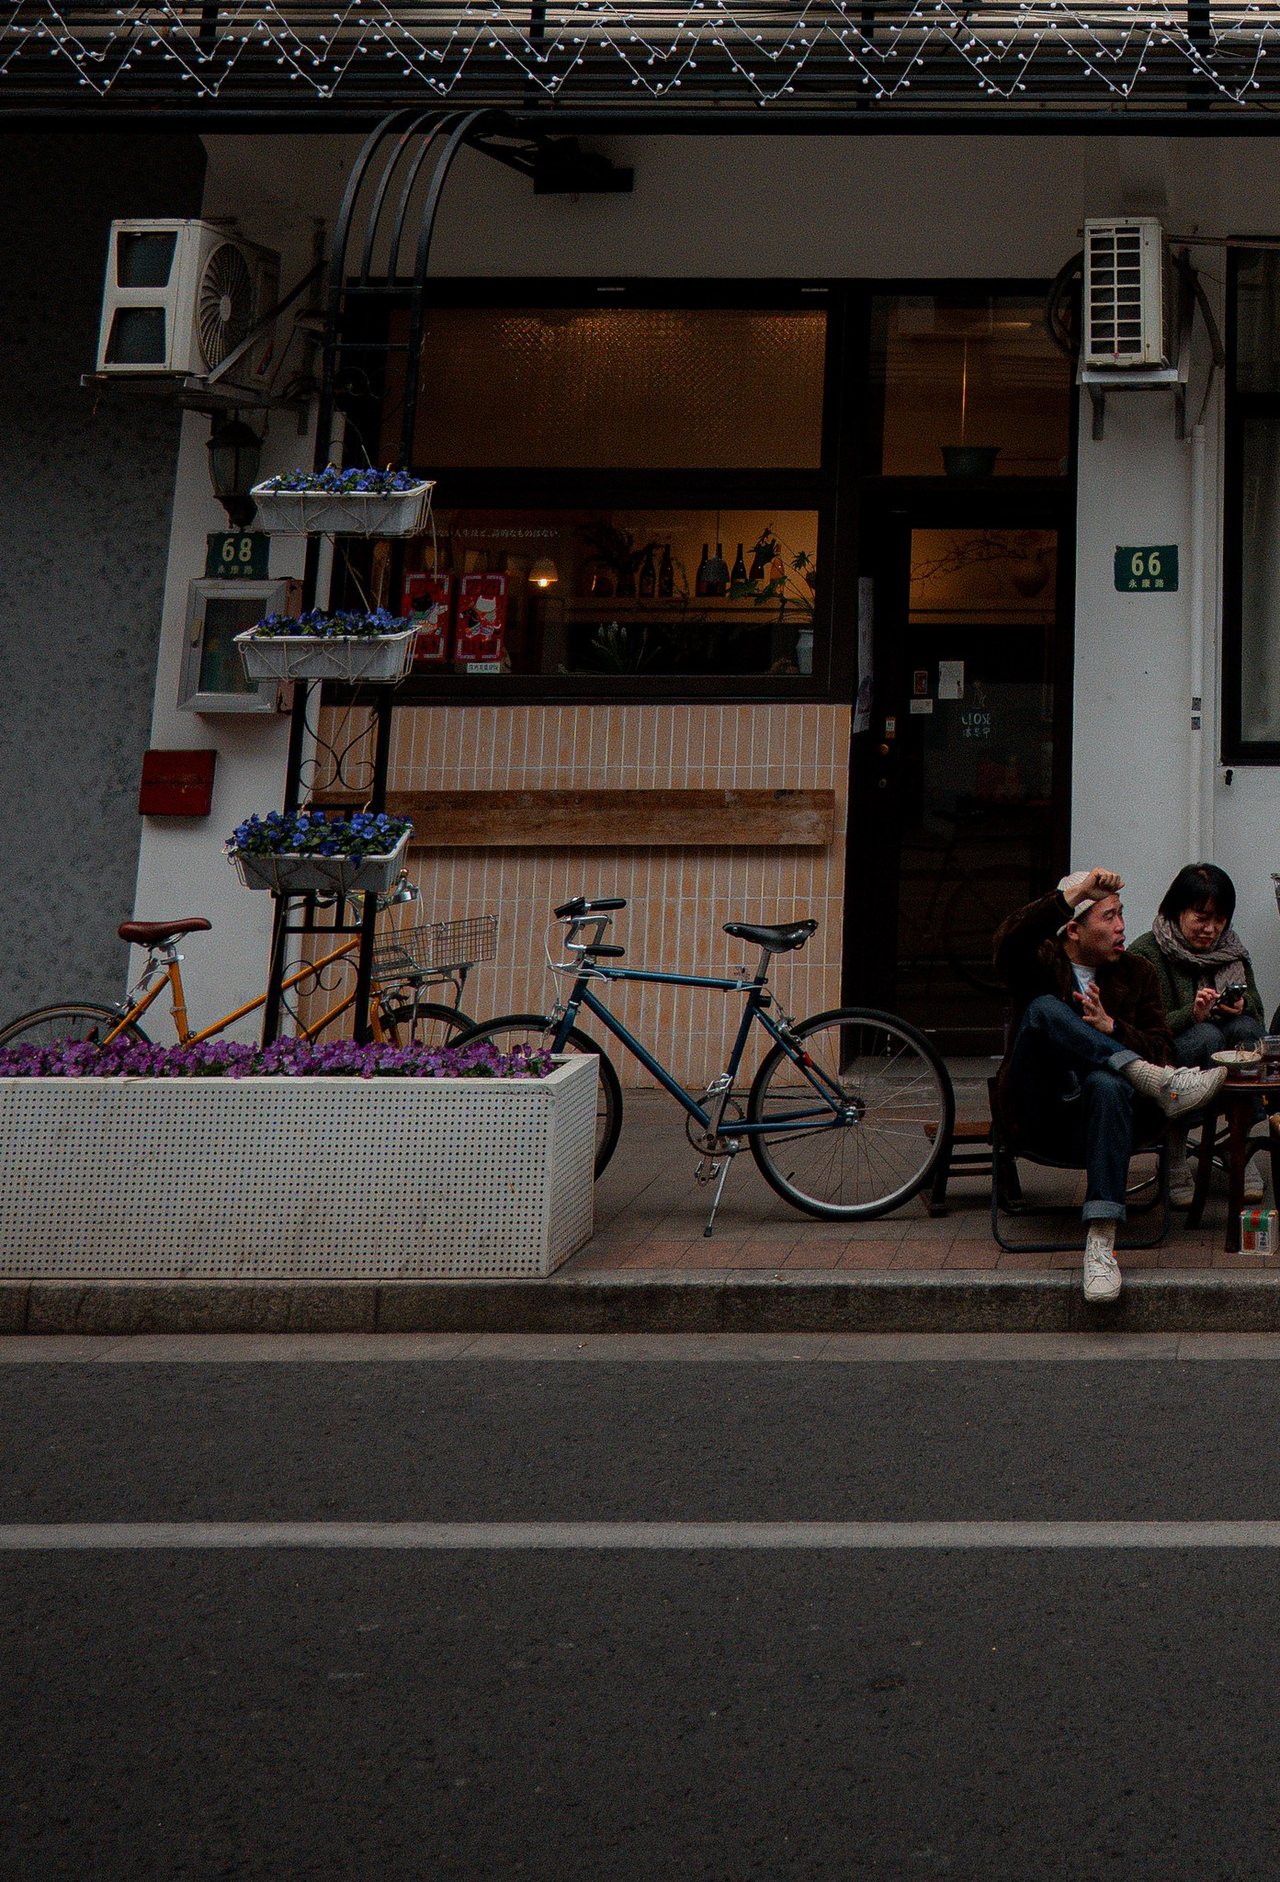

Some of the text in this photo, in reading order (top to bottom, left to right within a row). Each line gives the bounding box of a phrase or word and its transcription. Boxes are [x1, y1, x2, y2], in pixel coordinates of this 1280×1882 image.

[221, 537, 252, 563] 68
[1131, 551, 1161, 576] 66
[961, 713, 991, 725] CLOSE
